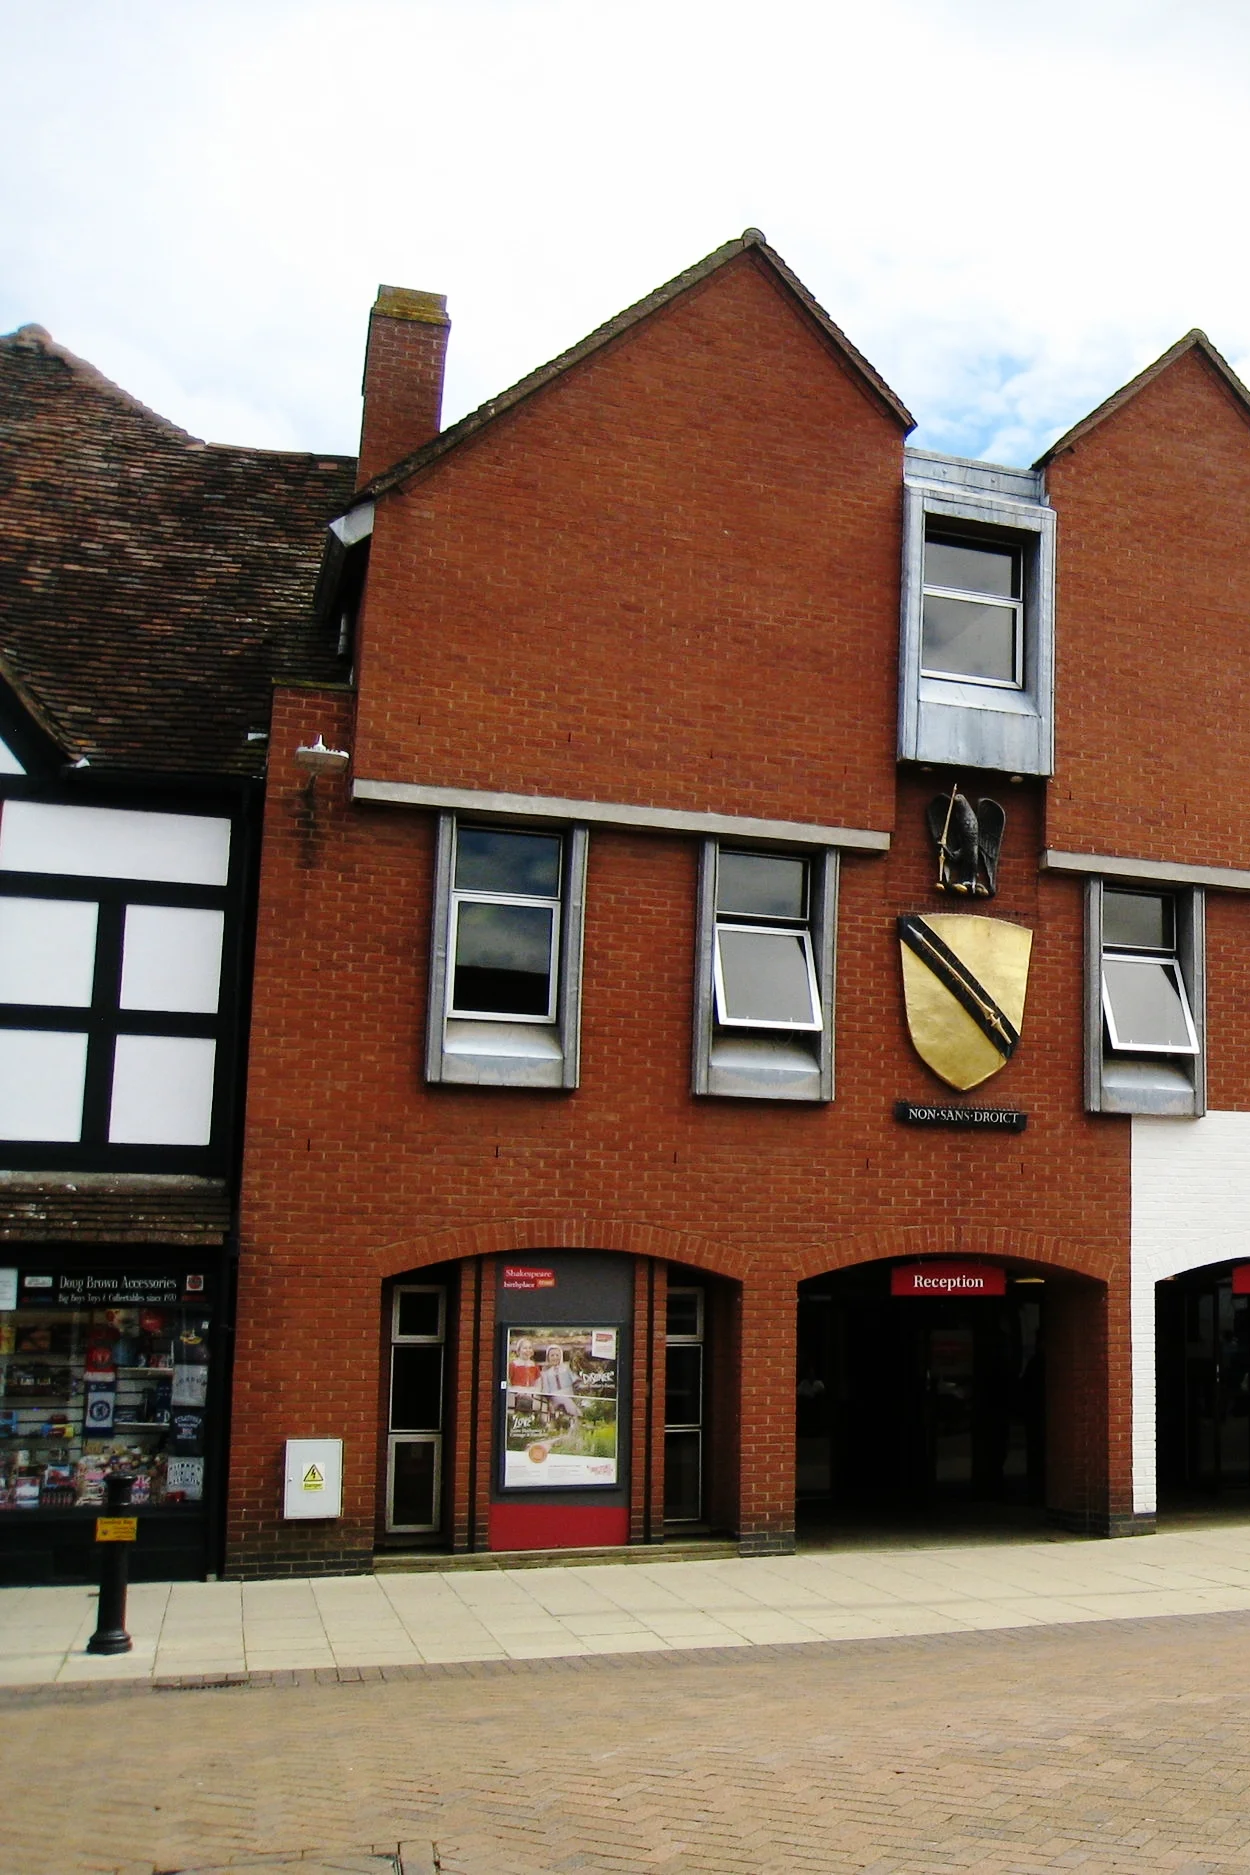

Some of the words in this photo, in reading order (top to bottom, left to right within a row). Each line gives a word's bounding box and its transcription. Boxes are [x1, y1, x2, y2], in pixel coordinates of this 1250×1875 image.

[505, 1269, 552, 1279] Shakespeare
[60, 1276, 83, 1293] Doug
[87, 1276, 118, 1289] Brown
[121, 1276, 177, 1289] Accessories
[913, 1275, 984, 1292] Reception
